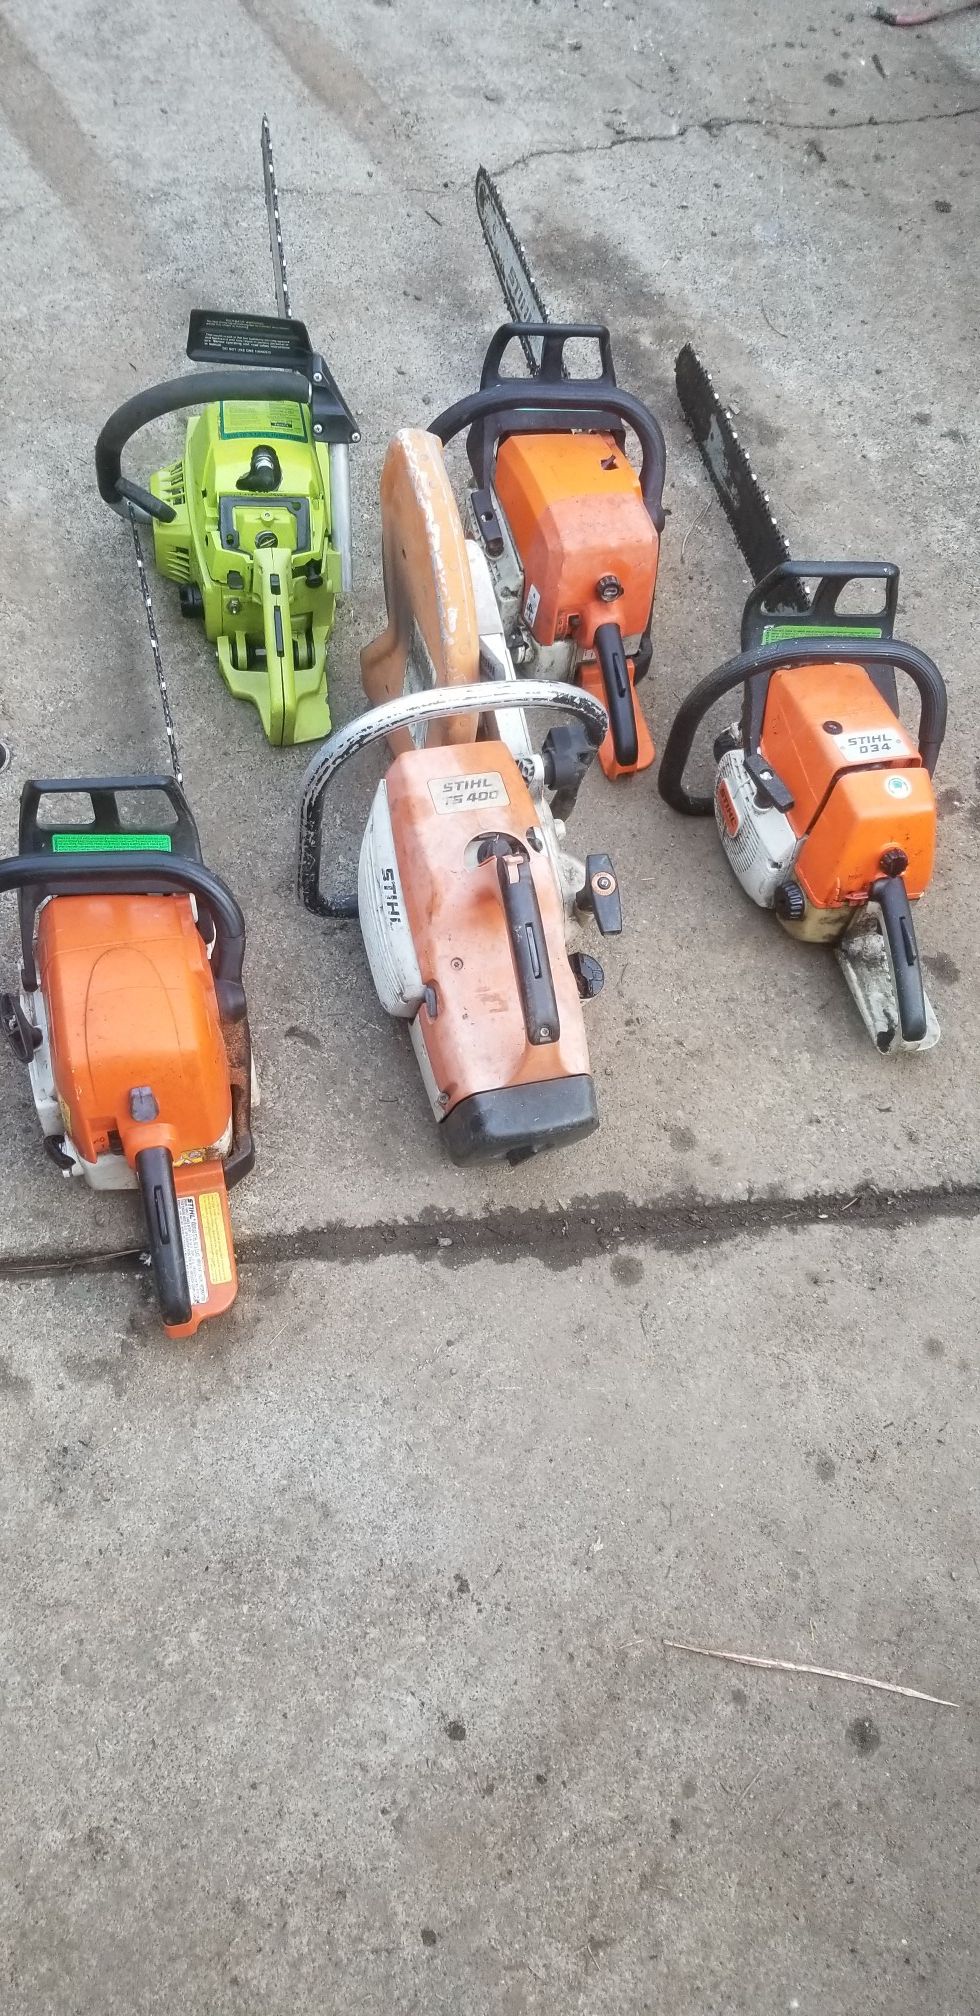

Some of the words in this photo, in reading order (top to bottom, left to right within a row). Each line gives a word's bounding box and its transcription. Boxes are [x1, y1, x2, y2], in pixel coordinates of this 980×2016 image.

[847, 734, 892, 747] STIHL
[859, 743, 892, 754] 034
[443, 778, 493, 792] STIHL
[466, 790, 499, 802] 400
[720, 787, 737, 827] STIHL
[187, 1198, 195, 1220] STIHL
